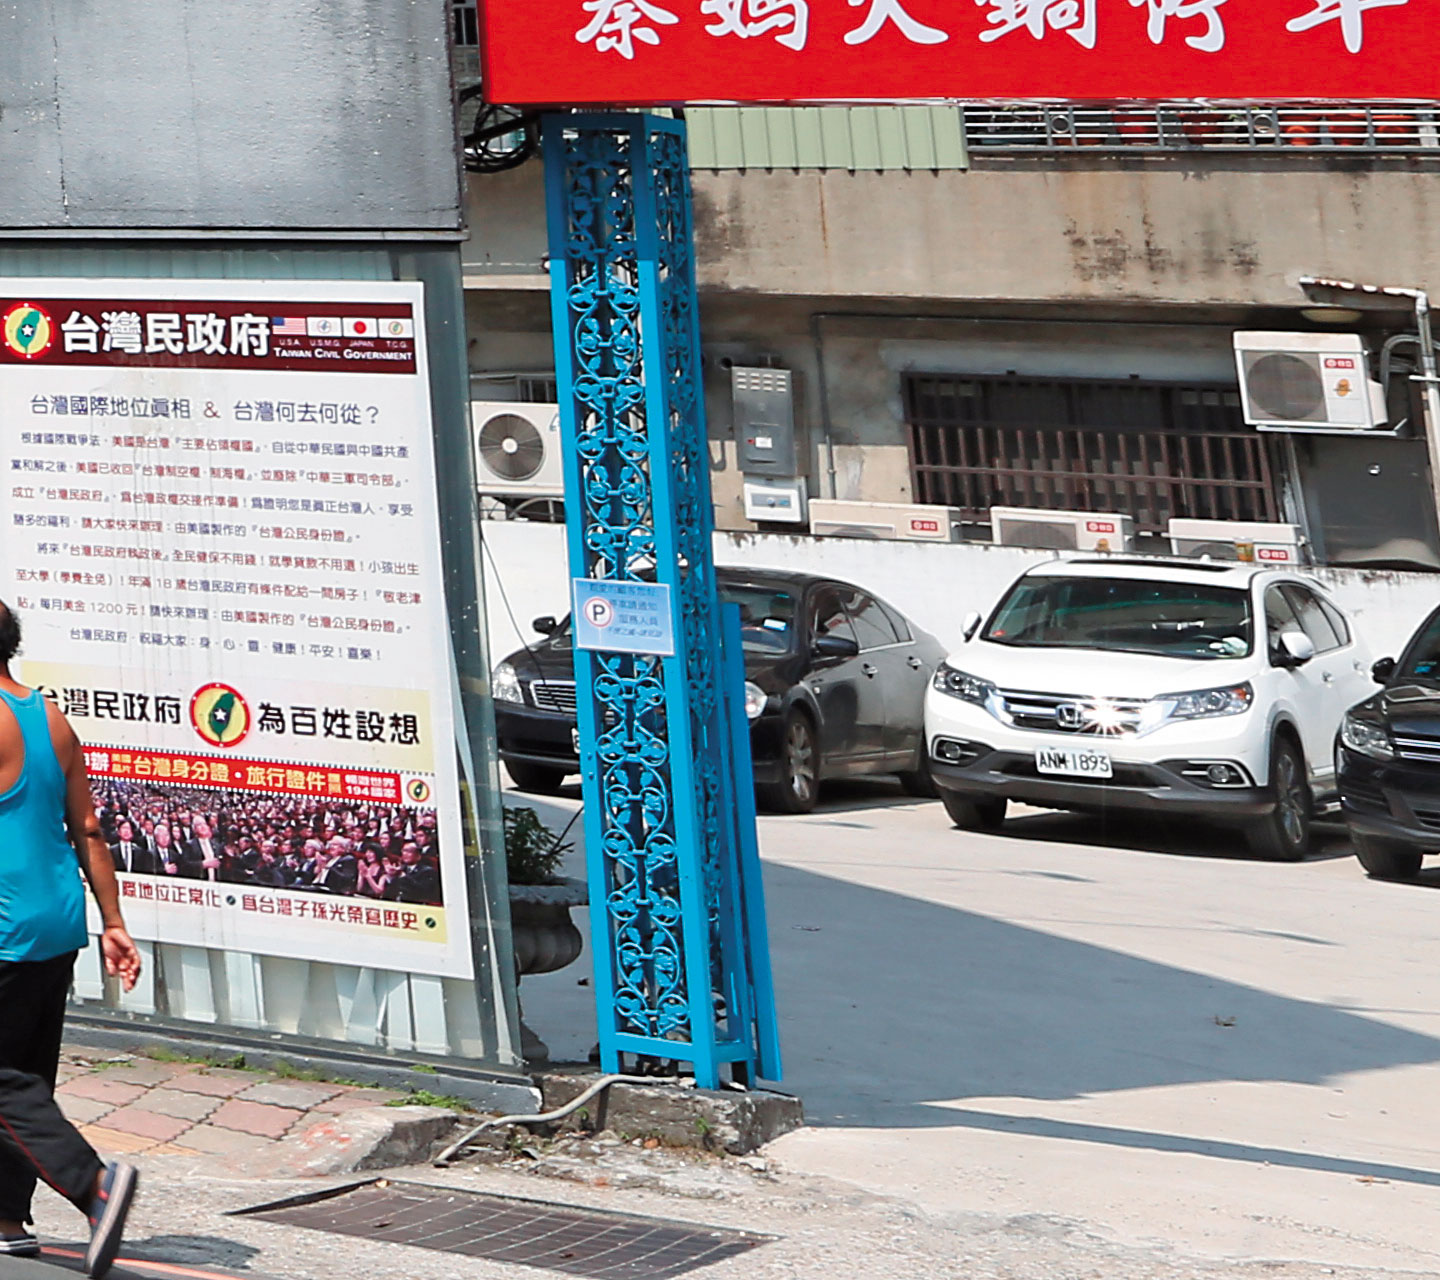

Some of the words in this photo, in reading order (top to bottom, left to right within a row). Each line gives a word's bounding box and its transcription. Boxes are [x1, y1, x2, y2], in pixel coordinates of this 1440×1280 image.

[61, 311, 270, 357] 台灣民政府
[273, 348, 312, 358] TAIWAN
[314, 348, 341, 359] CIVIL
[343, 349, 412, 360] GOVERNMENT
[203, 401, 221, 419] &
[593, 604, 605, 621] P
[258, 703, 420, 746] 為百姓設想
[117, 879, 221, 909] 際地位正常化
